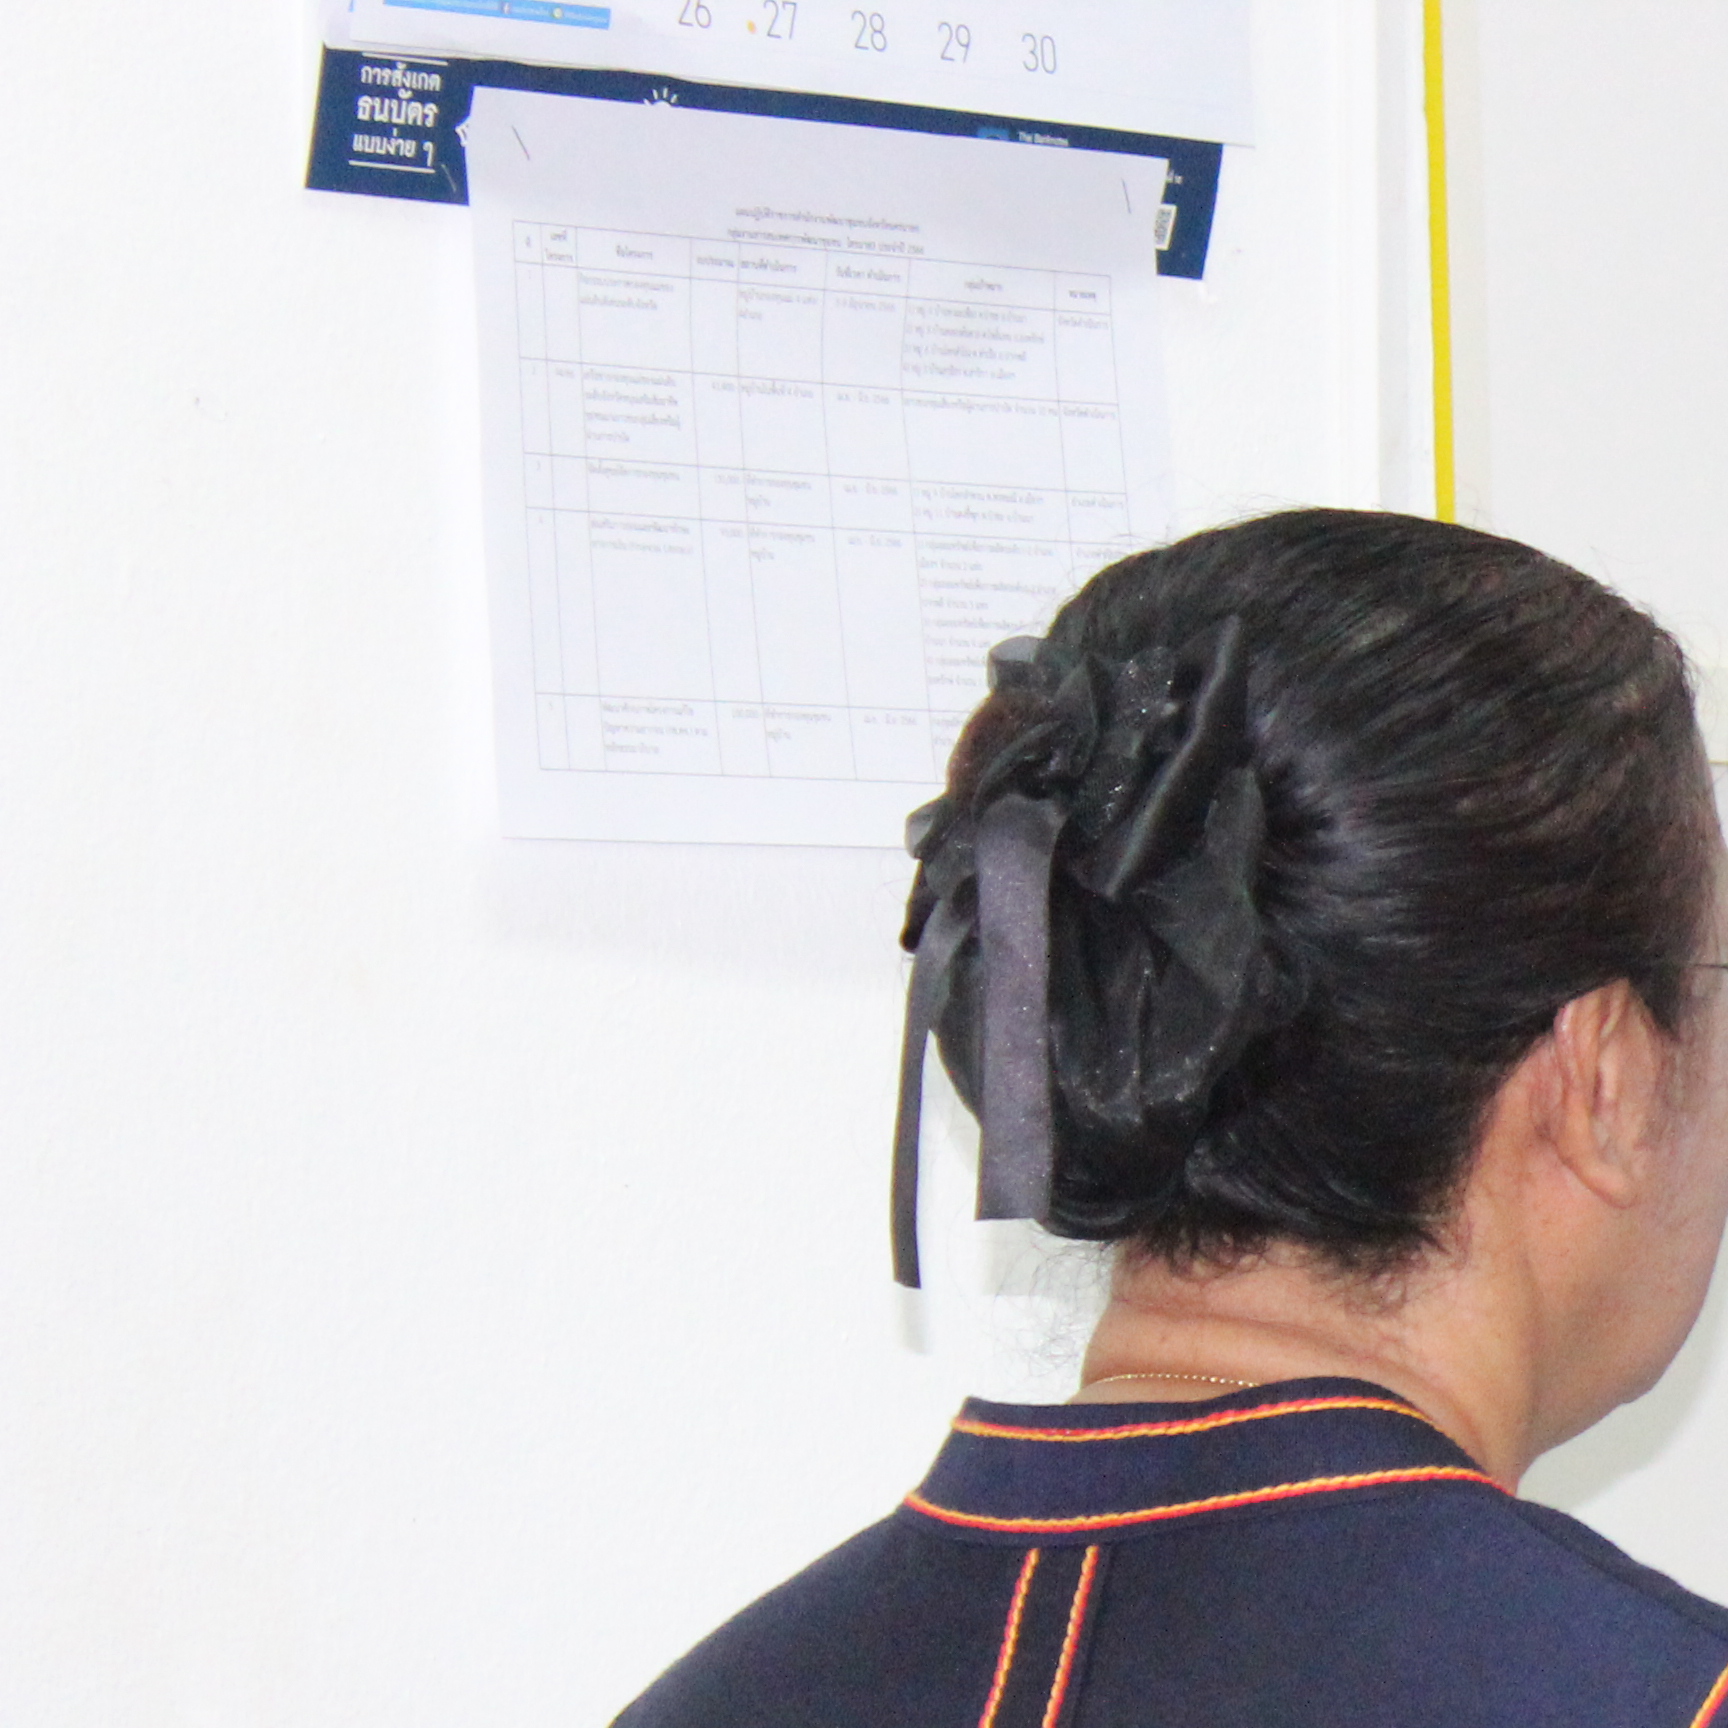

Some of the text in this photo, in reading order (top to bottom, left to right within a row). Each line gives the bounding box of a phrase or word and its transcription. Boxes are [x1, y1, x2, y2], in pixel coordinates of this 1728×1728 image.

[679, 0, 1057, 74] 26 27 28 29 30
[357, 90, 438, 127] ธนบัตร
